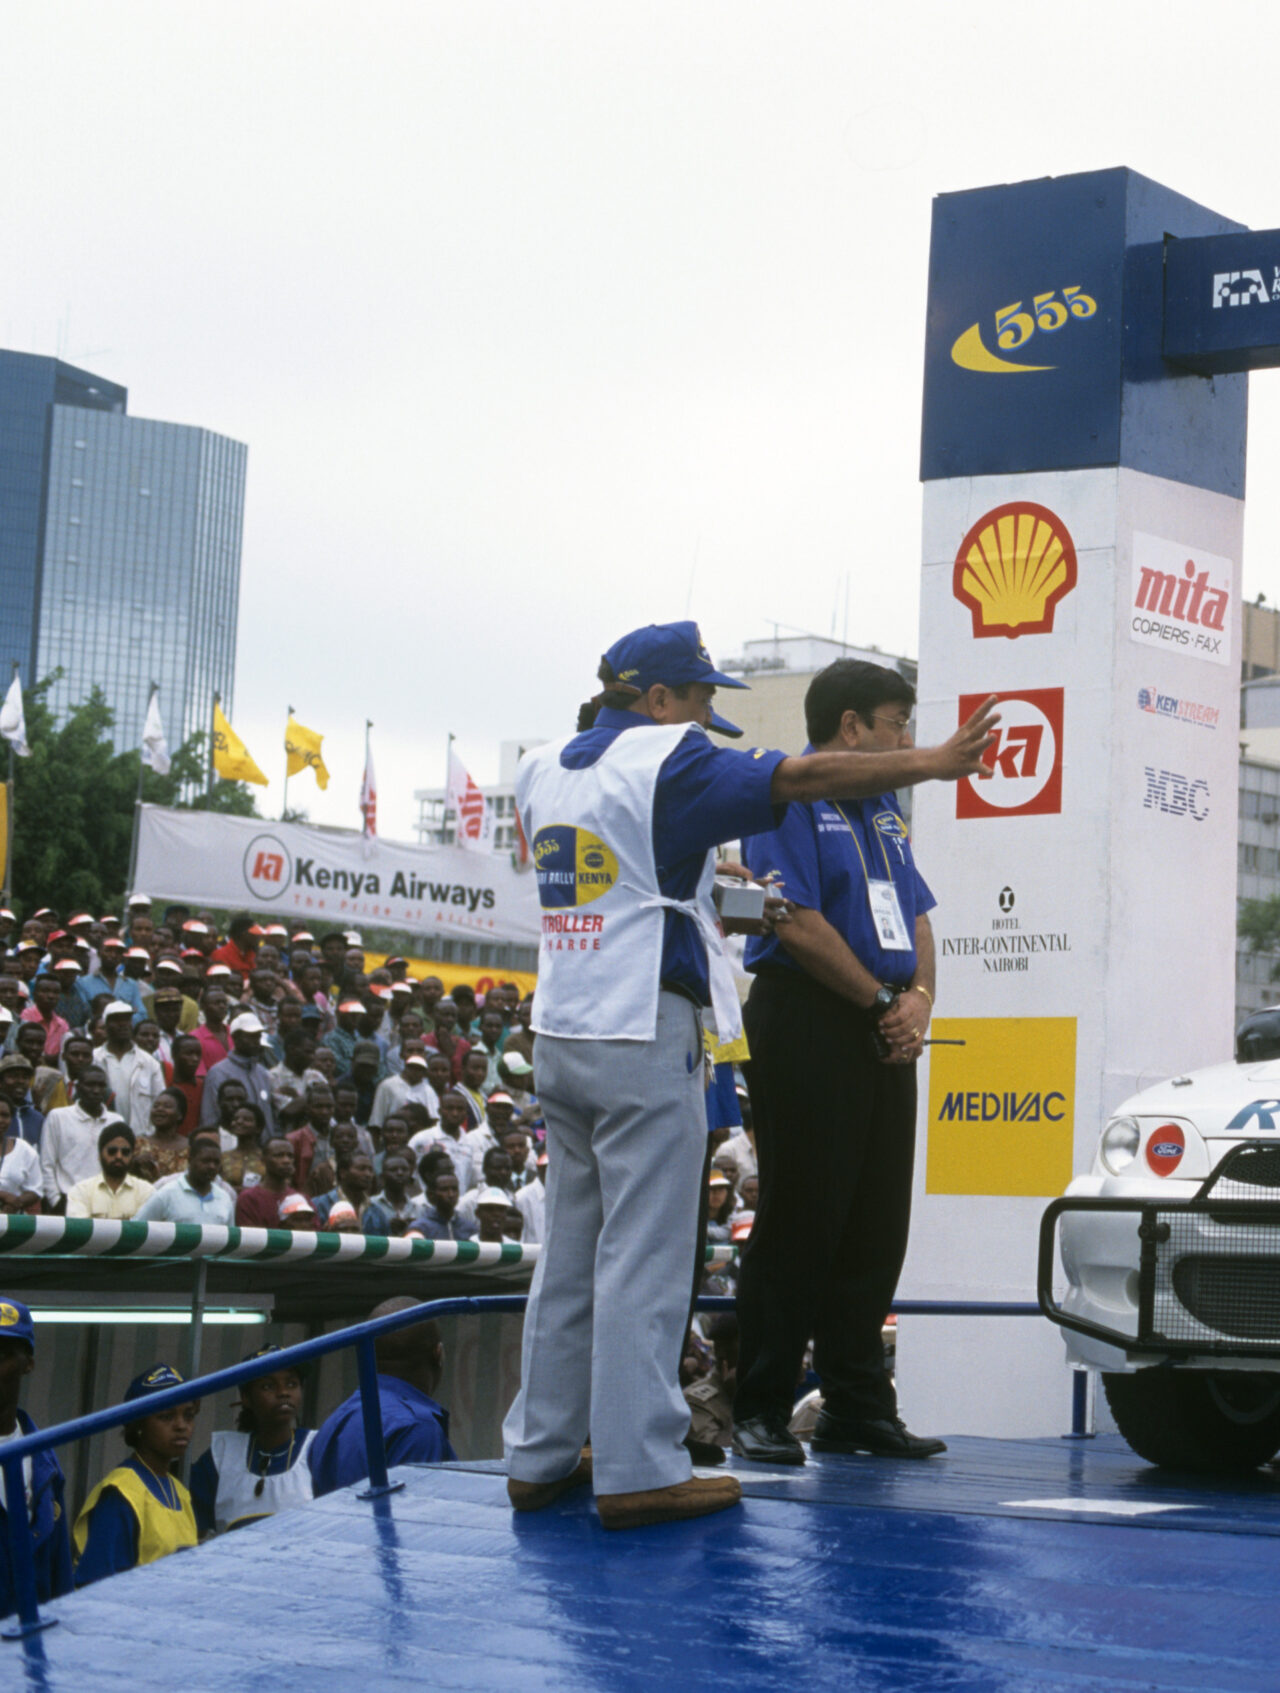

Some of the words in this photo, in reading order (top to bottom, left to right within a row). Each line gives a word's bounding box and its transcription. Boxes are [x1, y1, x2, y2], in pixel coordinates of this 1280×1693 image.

[1213, 269, 1270, 308] FIA
[995, 285, 1098, 353] 555
[1133, 559, 1231, 632] mita
[294, 857, 380, 895] Kenya
[389, 870, 496, 912] Airways
[549, 872, 575, 885] RALLY
[578, 872, 613, 885] KENYA
[542, 914, 604, 934] TROLLER
[992, 917, 1021, 931] HOTEL
[543, 938, 601, 951] HARGE
[942, 933, 1072, 957] INTER-CONTINENTAL
[982, 956, 1029, 973] NAIROBI
[938, 1091, 1067, 1122] MEDIVAC
